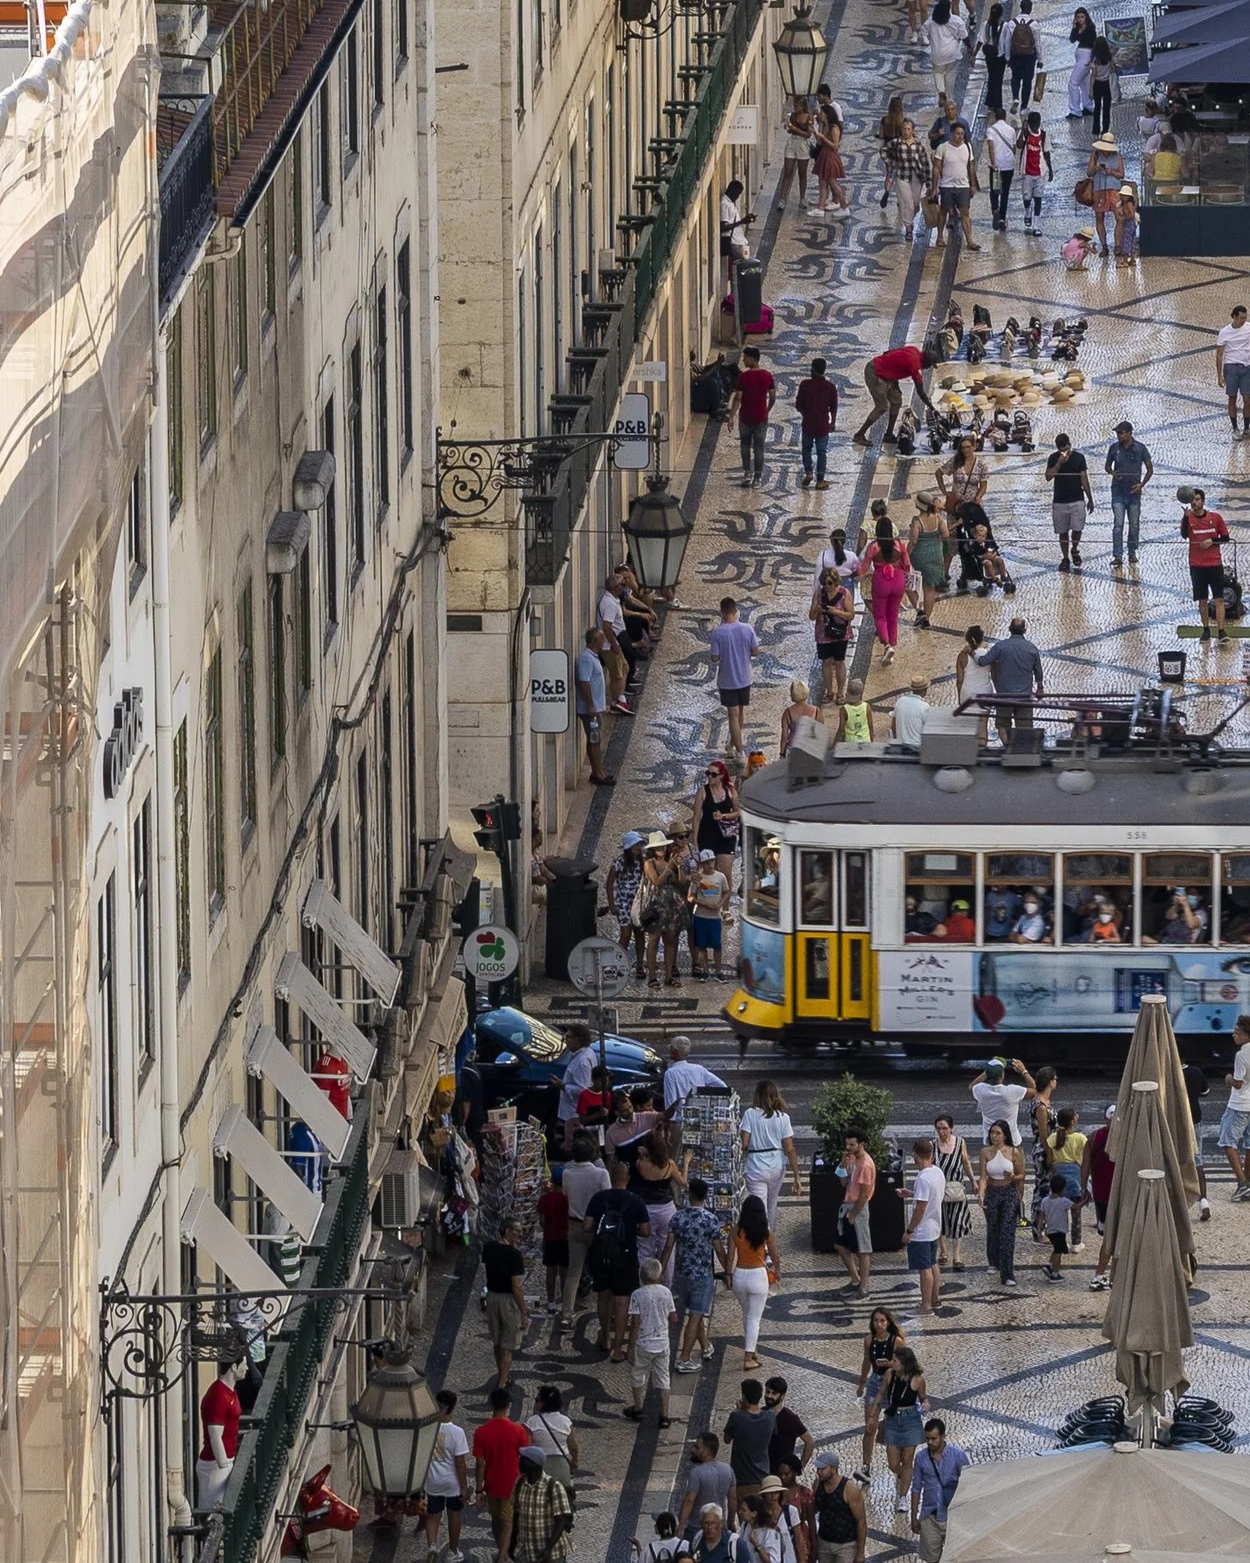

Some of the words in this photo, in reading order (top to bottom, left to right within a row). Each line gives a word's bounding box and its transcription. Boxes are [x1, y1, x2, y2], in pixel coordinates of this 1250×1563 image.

[616, 420, 646, 434] P&B
[531, 679, 566, 695] P&B
[475, 962, 506, 974] JOGOS
[900, 973, 954, 983] MARTIN
